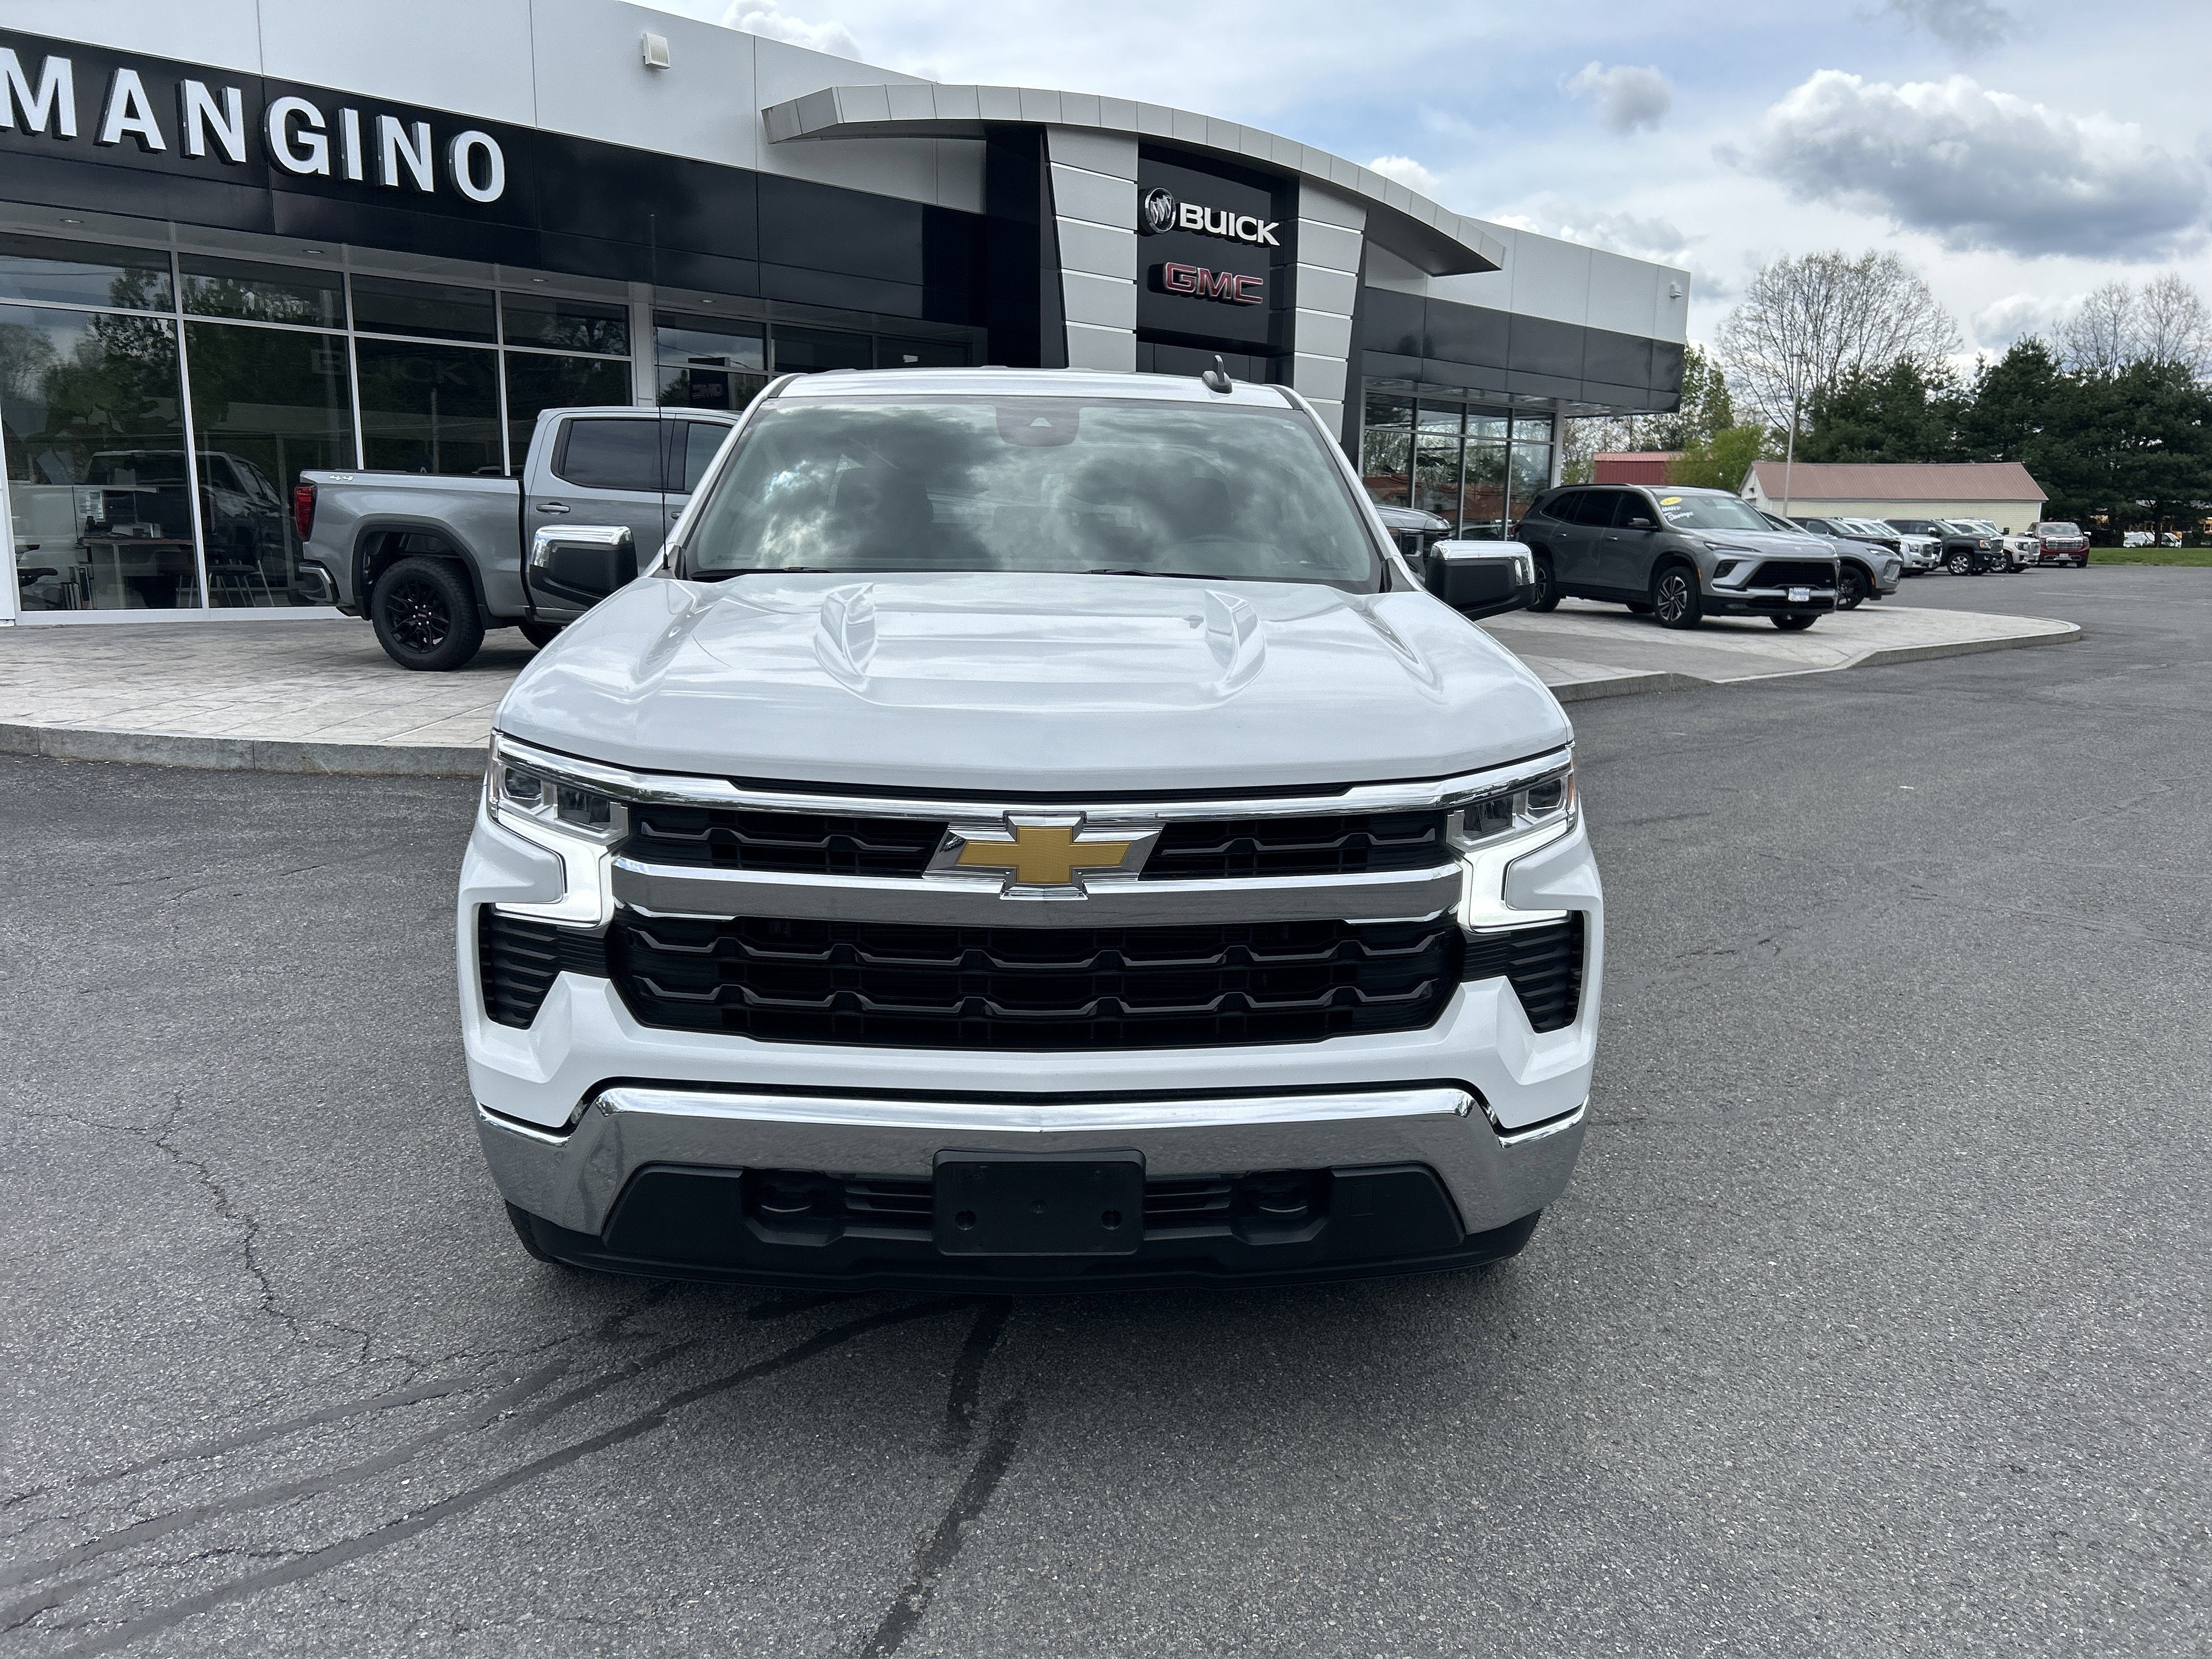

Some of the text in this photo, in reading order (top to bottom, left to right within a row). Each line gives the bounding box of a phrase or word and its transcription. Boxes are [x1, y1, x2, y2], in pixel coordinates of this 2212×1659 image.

[0, 47, 506, 203] MANGINO
[1180, 202, 1280, 246] BUICK
[1165, 262, 1263, 304] GMC
